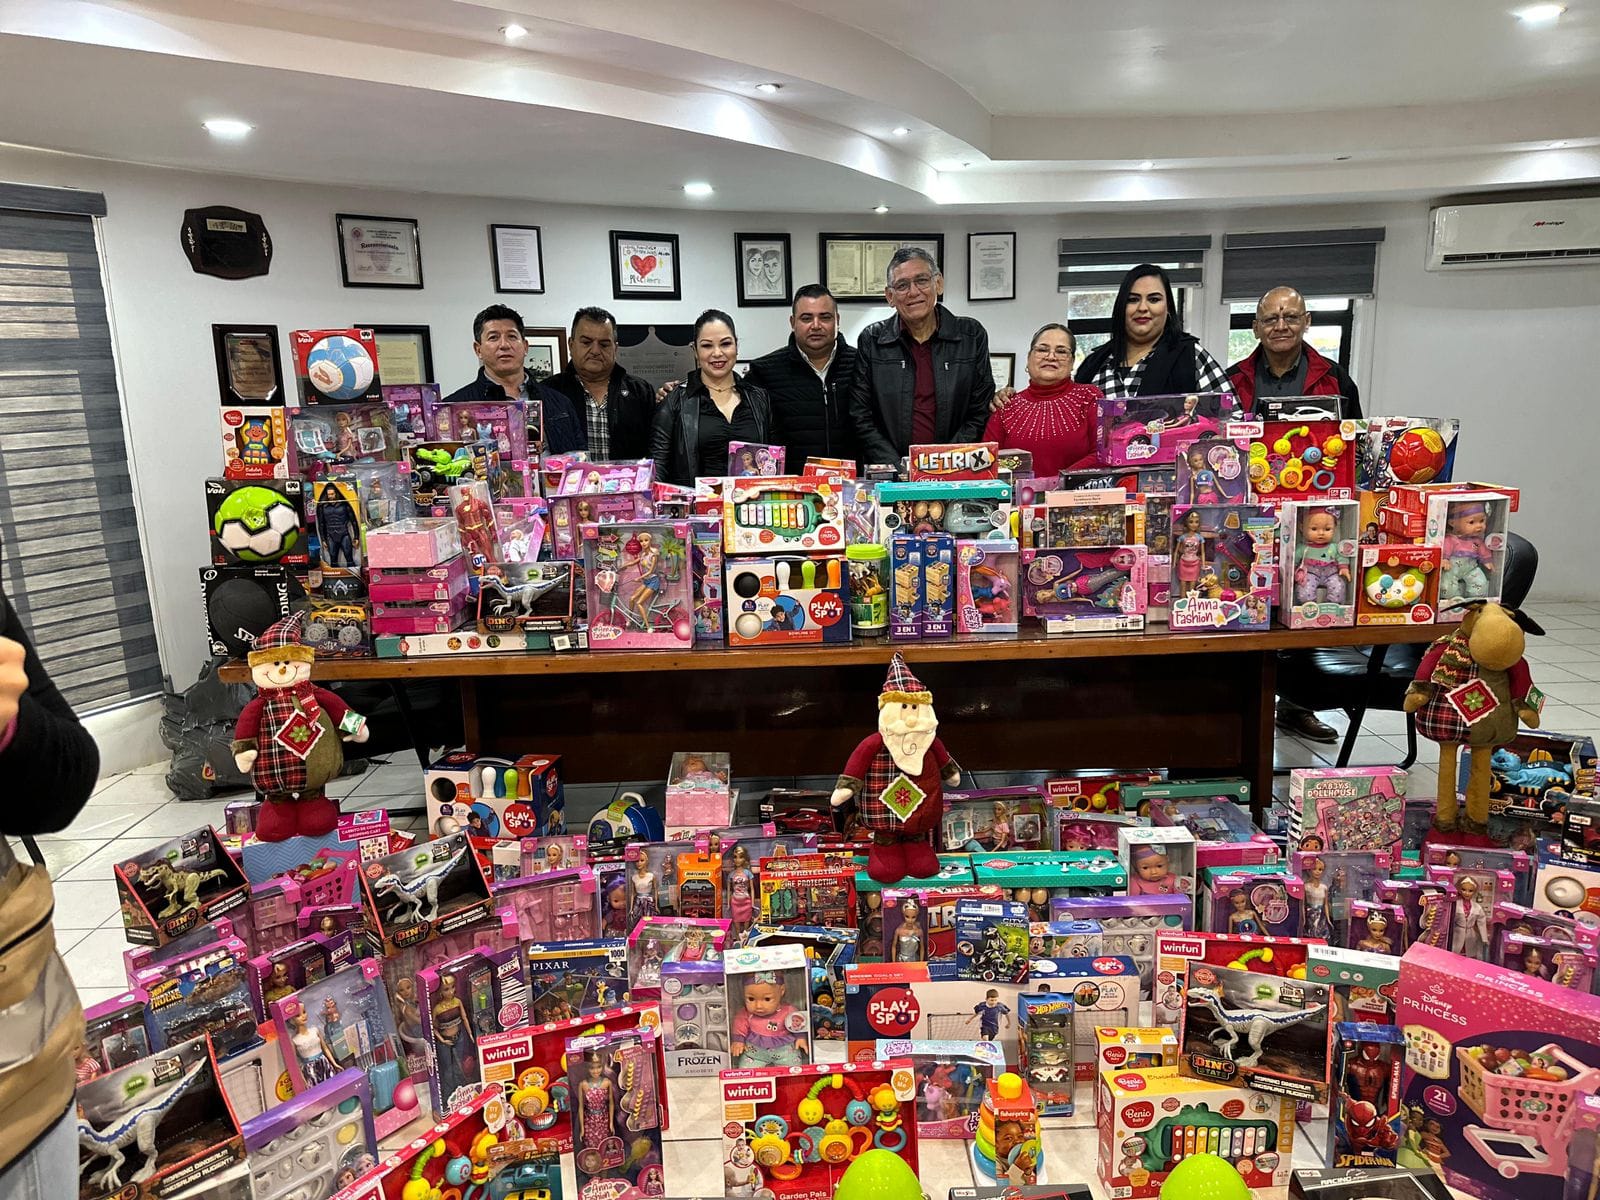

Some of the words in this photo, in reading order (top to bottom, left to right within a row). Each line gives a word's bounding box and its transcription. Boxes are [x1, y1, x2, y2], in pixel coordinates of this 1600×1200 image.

[918, 447, 988, 471] LETRIX
[473, 557, 486, 565] DC
[811, 602, 837, 611] PLAY
[1188, 598, 1218, 612] Anna
[815, 608, 842, 618] SPOT
[1174, 610, 1214, 625] Fashion
[1308, 788, 1356, 797] DOLLHOUSE
[506, 812, 530, 820] PLAY
[509, 819, 535, 828] SPOT
[790, 868, 843, 876] PROTECTION
[168, 910, 196, 930] DINO
[396, 924, 428, 939] DINO
[1164, 943, 1199, 953] winfun
[235, 951, 245, 959] 3+
[610, 950, 624, 958] 1000
[532, 960, 570, 970] PIXAR
[366, 967, 375, 975] 3+
[1474, 973, 1544, 998] PRINCESS
[1420, 990, 1453, 1012] Disney
[870, 1002, 910, 1016] PLAY
[1402, 996, 1468, 1026] PRINCESS
[876, 1010, 918, 1026] SPOT
[486, 1046, 526, 1061] winfun
[1106, 1050, 1124, 1058] Benic
[678, 1054, 721, 1066] FROZEN
[1194, 1056, 1233, 1072] DINO
[724, 1070, 751, 1078] winfun
[894, 1074, 910, 1086] Try
[1118, 1076, 1144, 1084] Benic
[1392, 1060, 1400, 1100] SPIDER-MAN
[727, 1087, 768, 1098] winfun
[1434, 1090, 1447, 1102] 21
[1126, 1110, 1152, 1118] Benic
[1336, 1154, 1394, 1168] SPIDER-MAN
[1320, 1176, 1352, 1186] RACING
[591, 1183, 613, 1192] Anna
[780, 1192, 807, 1200] Garden
[810, 1190, 827, 1198] Pals
